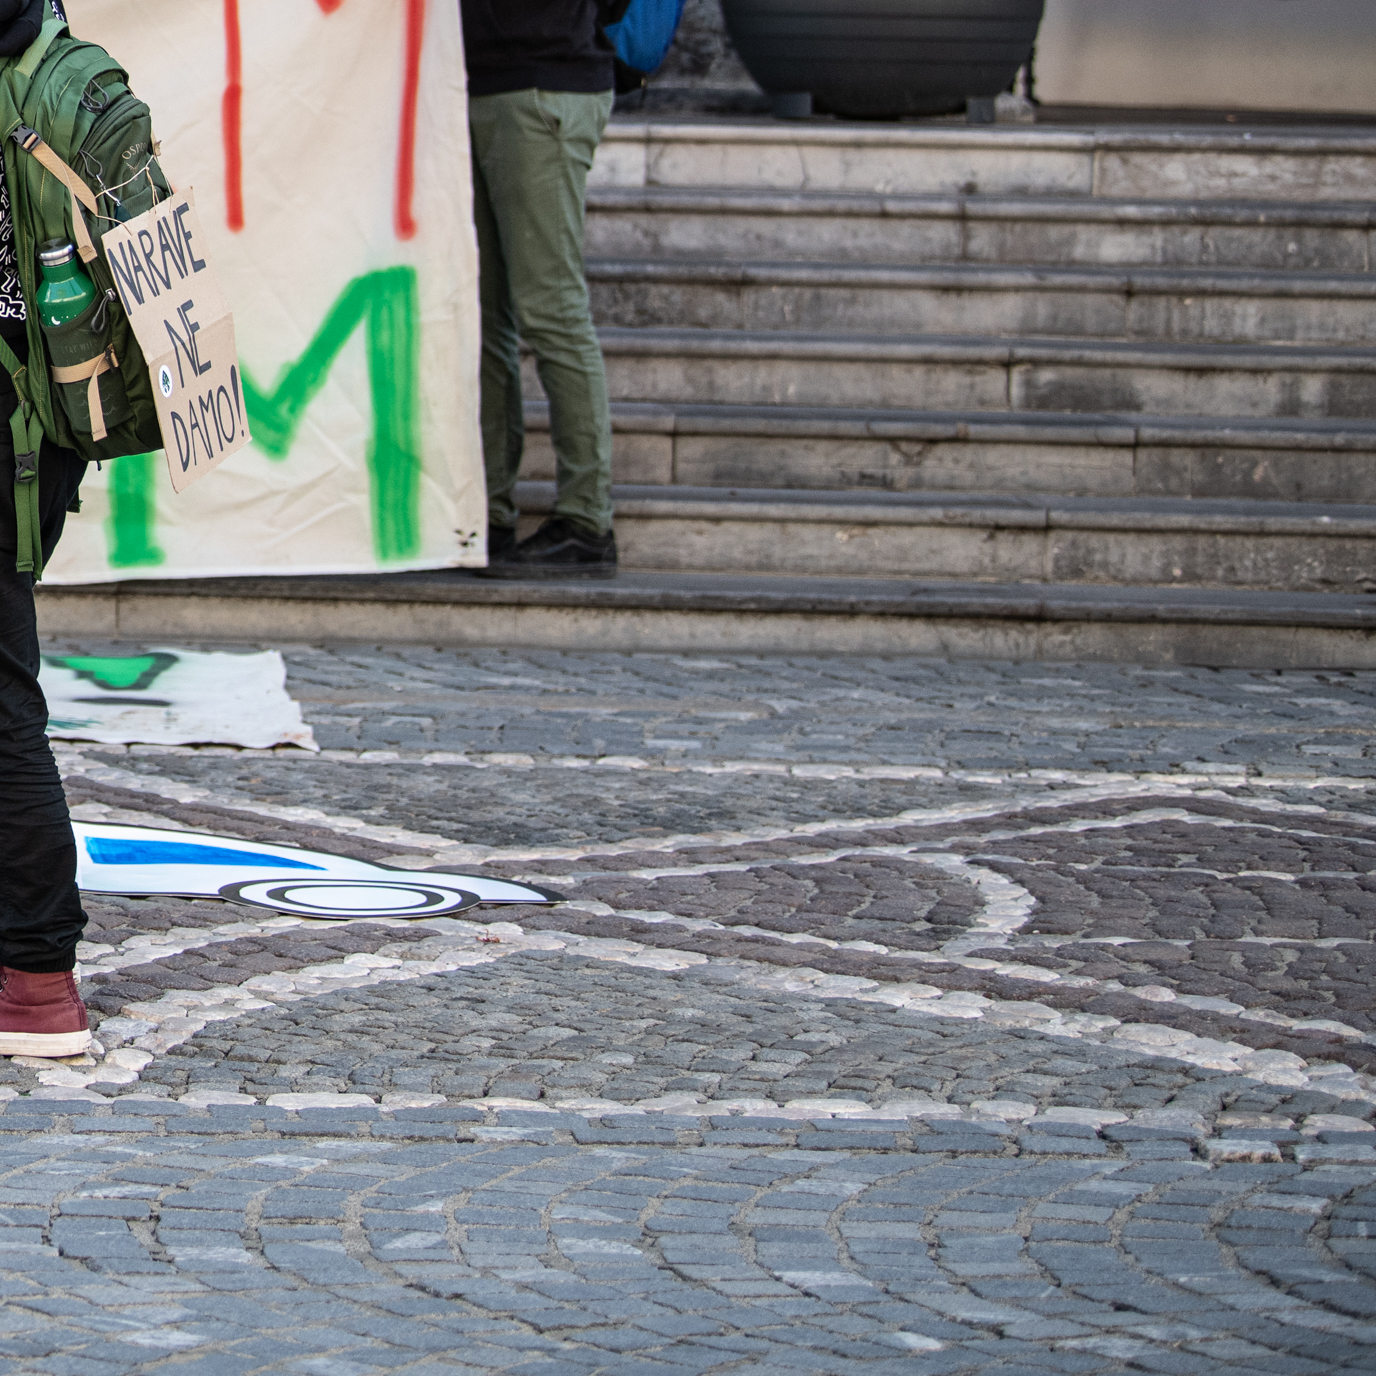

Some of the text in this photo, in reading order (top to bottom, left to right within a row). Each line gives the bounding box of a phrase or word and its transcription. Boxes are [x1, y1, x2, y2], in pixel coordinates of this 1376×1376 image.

[107, 202, 206, 316] NARAVE
[163, 299, 212, 388] NE
[170, 364, 245, 472] DAMO!
